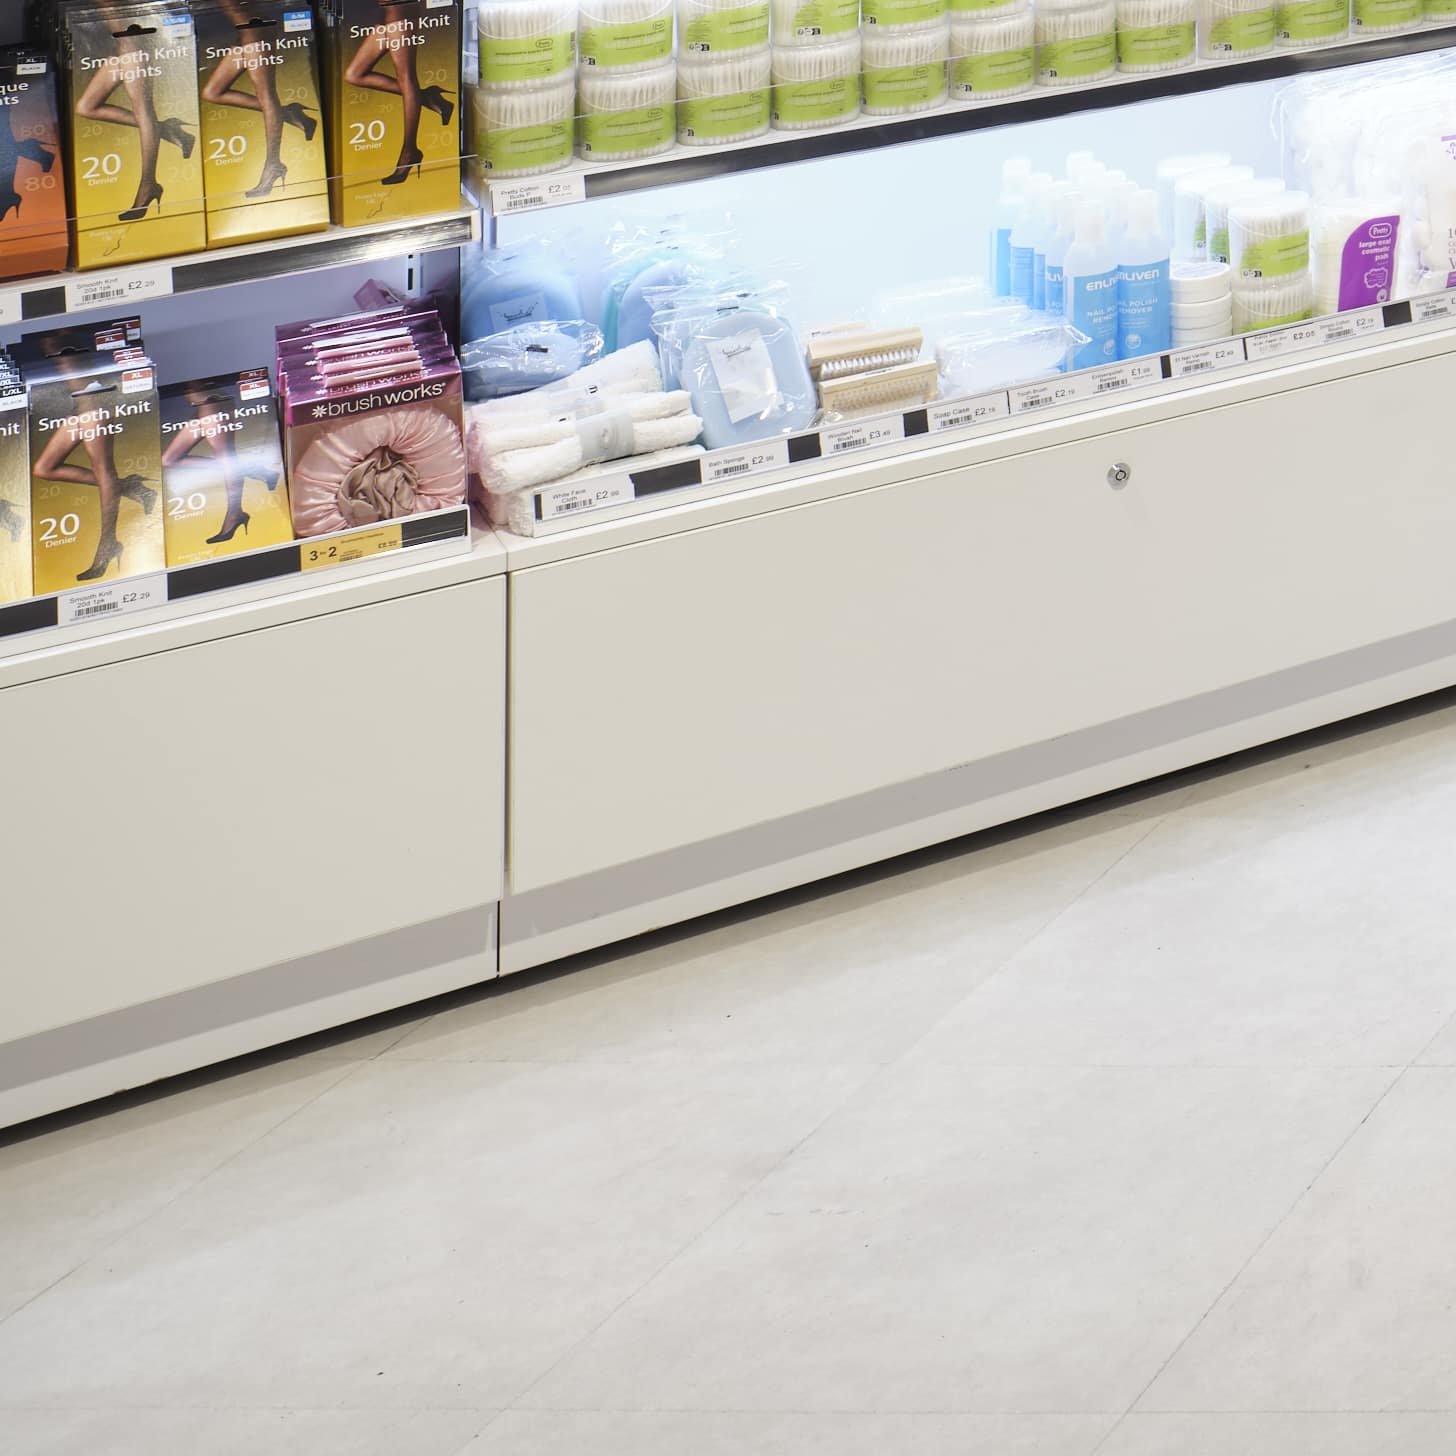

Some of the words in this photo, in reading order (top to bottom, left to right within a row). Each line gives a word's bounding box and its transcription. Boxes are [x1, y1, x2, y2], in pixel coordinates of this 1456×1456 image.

[349, 17, 415, 40] Smooth
[417, 12, 451, 31] Knit
[205, 39, 272, 61] Smooth
[275, 36, 309, 50] Knit
[375, 32, 426, 53] Tights
[80, 47, 151, 71] Smooth
[153, 45, 189, 61] Knit
[232, 52, 285, 72] Tights
[108, 63, 163, 84] Tights
[348, 118, 386, 145] 20
[208, 134, 248, 160] 20
[353, 140, 383, 152] Denier
[327, 392, 383, 419] brush
[386, 381, 444, 407] works
[38, 407, 111, 433] Smooth
[113, 400, 152, 417] Knit
[67, 421, 125, 443] Tights
[38, 512, 81, 543] 20
